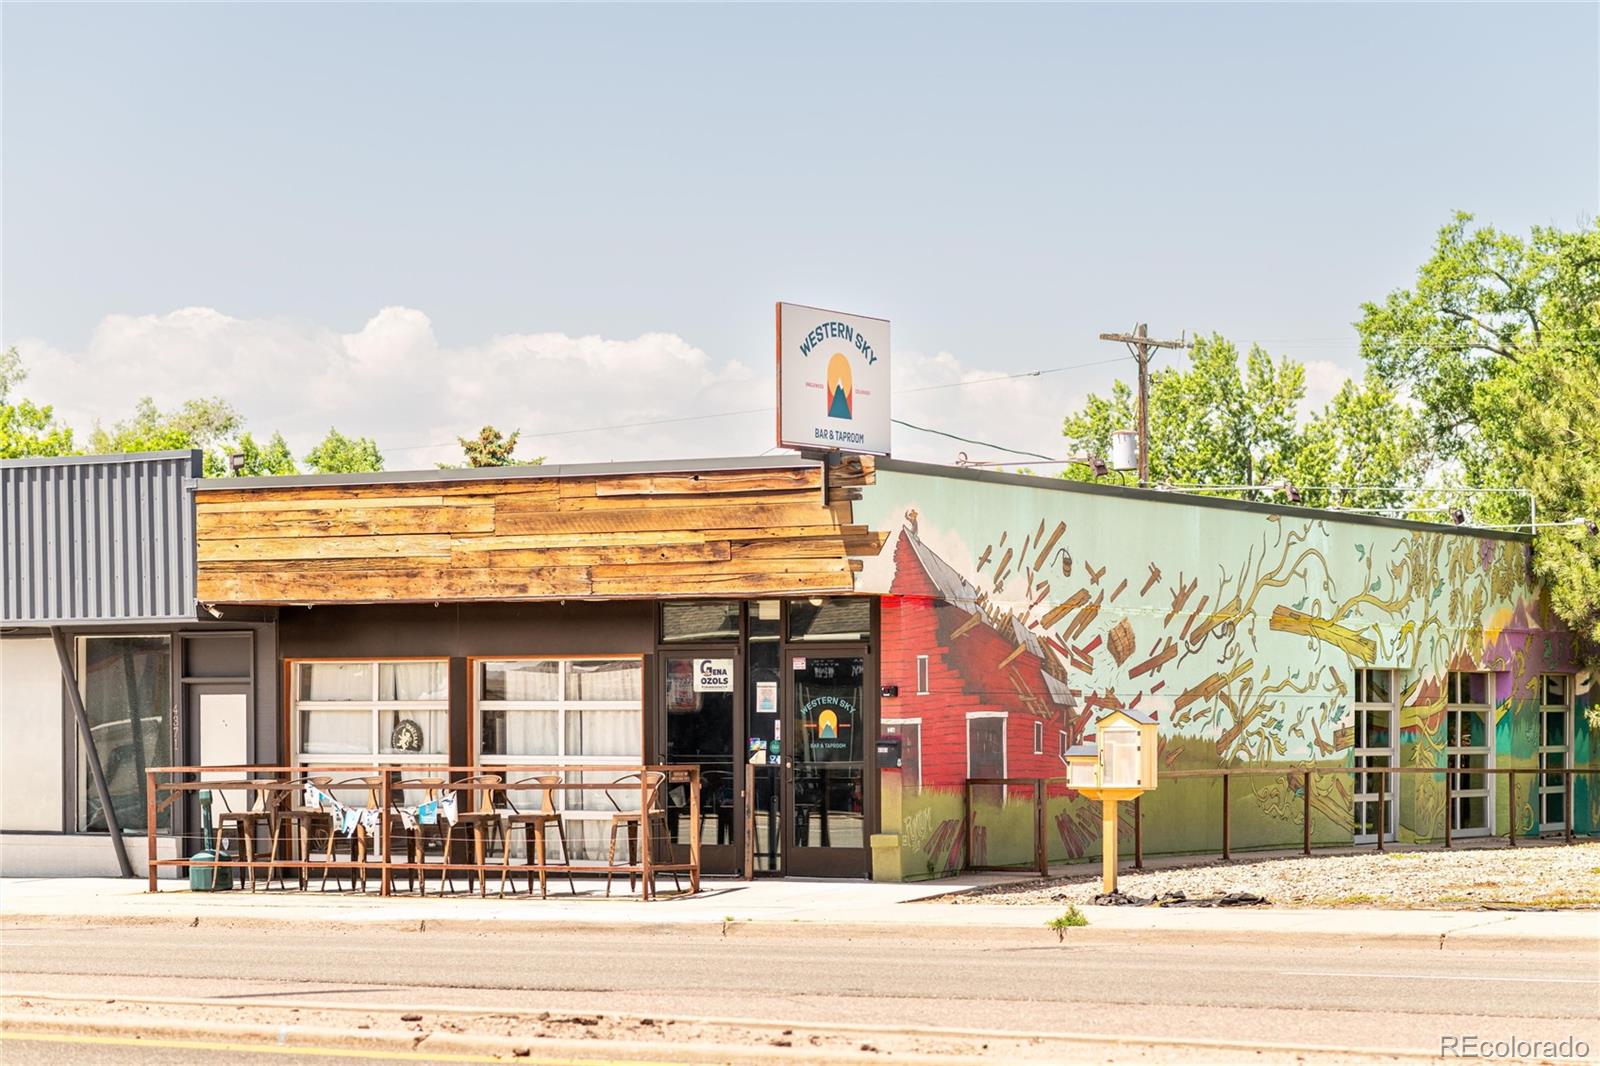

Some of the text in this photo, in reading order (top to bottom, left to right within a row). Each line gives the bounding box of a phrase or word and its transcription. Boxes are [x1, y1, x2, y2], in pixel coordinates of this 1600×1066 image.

[799, 321, 878, 366] WESTERN SKY
[815, 427, 865, 445] BAR & TAPROOM
[700, 659, 728, 677] GENA
[700, 677, 729, 685] OZOLS
[800, 695, 856, 715] WESTERN SKY
